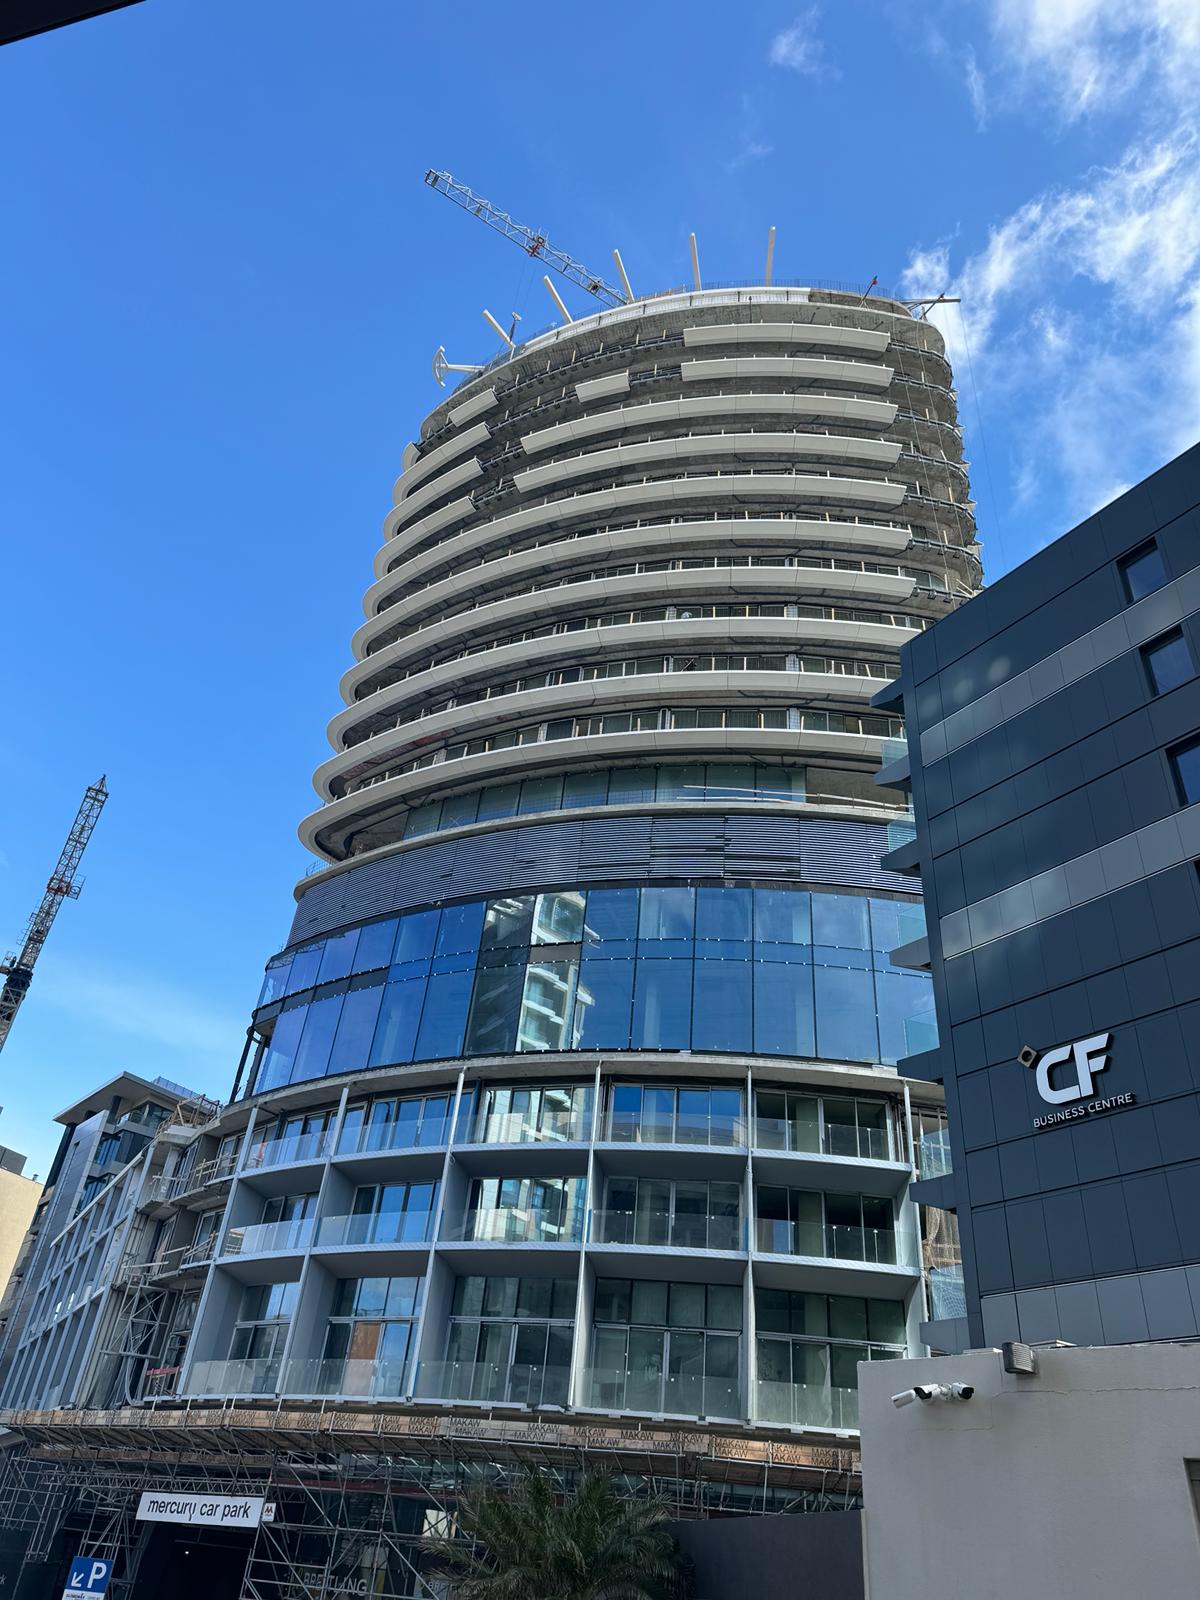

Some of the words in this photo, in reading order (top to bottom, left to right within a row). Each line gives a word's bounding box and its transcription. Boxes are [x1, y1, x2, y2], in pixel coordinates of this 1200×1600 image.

[1036, 1032, 1110, 1105] CF
[1033, 1105, 1085, 1128] BUSINESS
[1087, 1092, 1133, 1113] CENTRE
[527, 1423, 561, 1433] MAKAW
[620, 1430, 655, 1440] MAKAW
[147, 1499, 197, 1521] mercury
[200, 1502, 221, 1517] car
[220, 1501, 251, 1521] park
[87, 1561, 107, 1589] P
[303, 1572, 368, 1597] BRETLING
